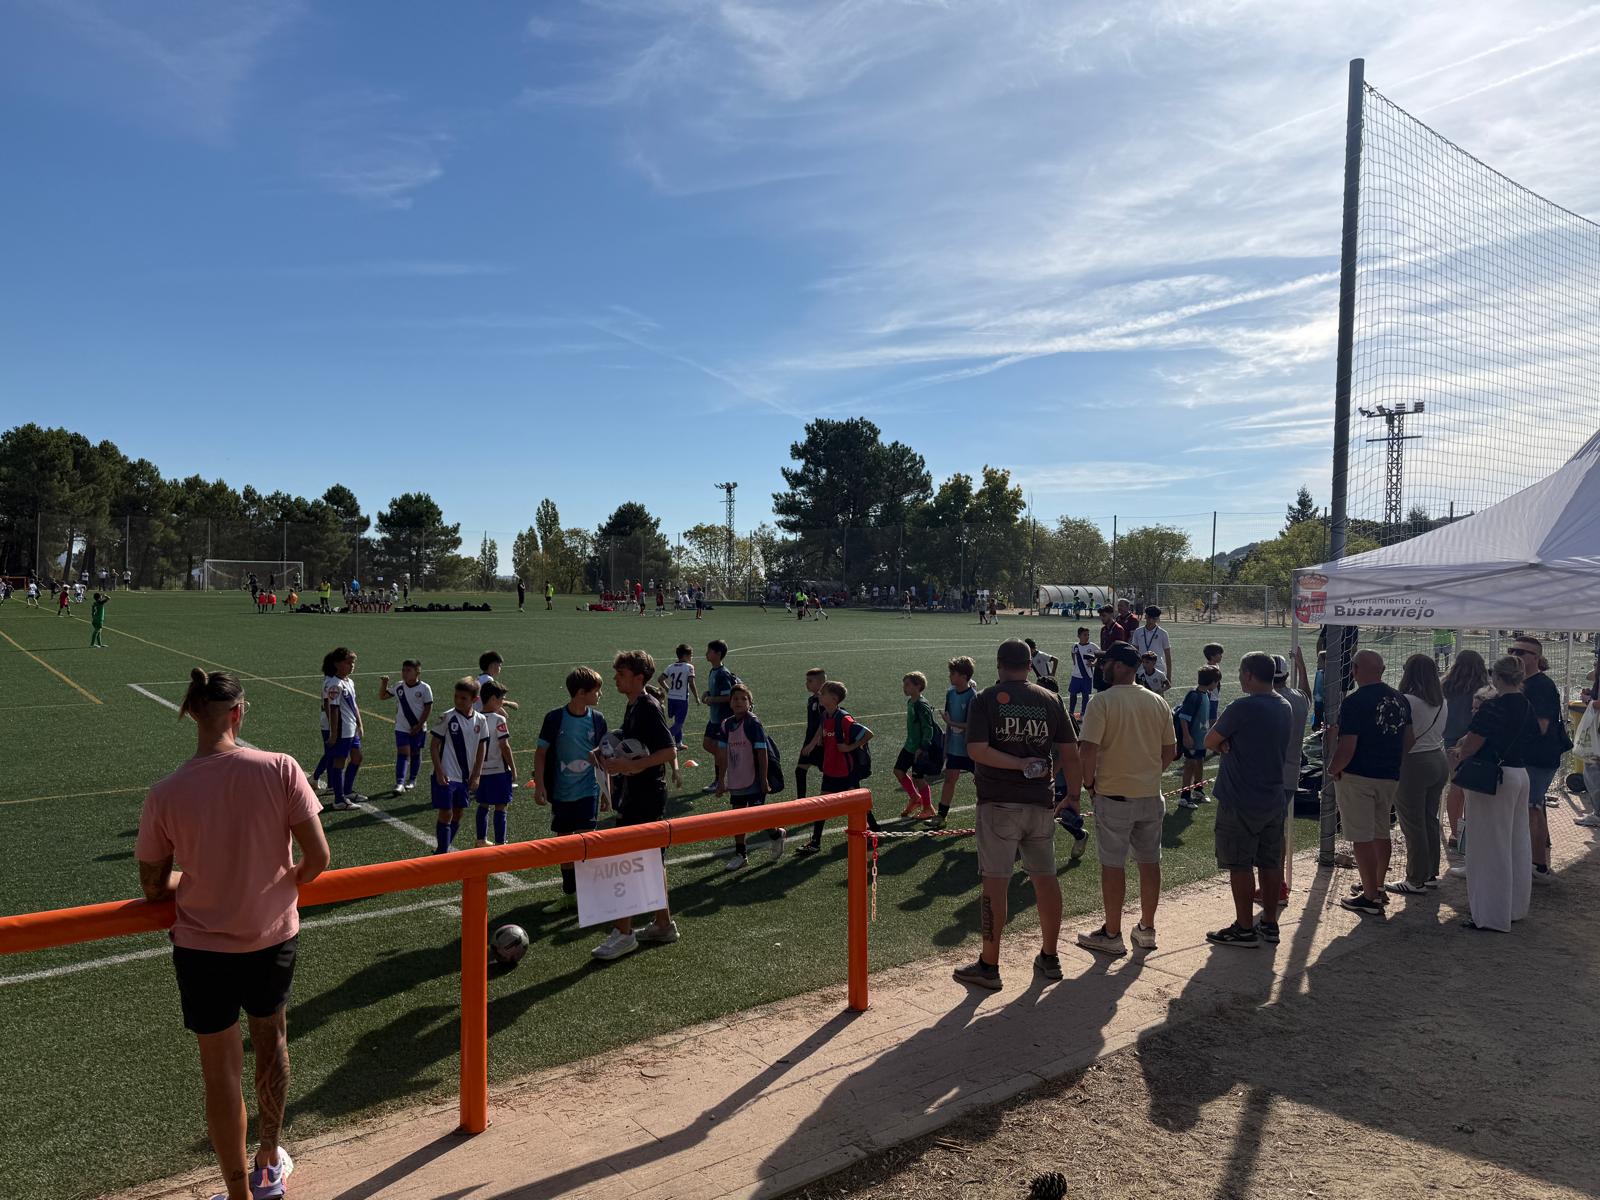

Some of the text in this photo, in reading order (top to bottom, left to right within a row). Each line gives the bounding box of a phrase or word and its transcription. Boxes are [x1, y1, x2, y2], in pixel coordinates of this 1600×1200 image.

[1346, 597, 1427, 605] Ayuntamiento de
[1334, 605, 1435, 620] Bustarviejo
[670, 672, 683, 690] 16
[1005, 717, 1049, 737] PLAYA
